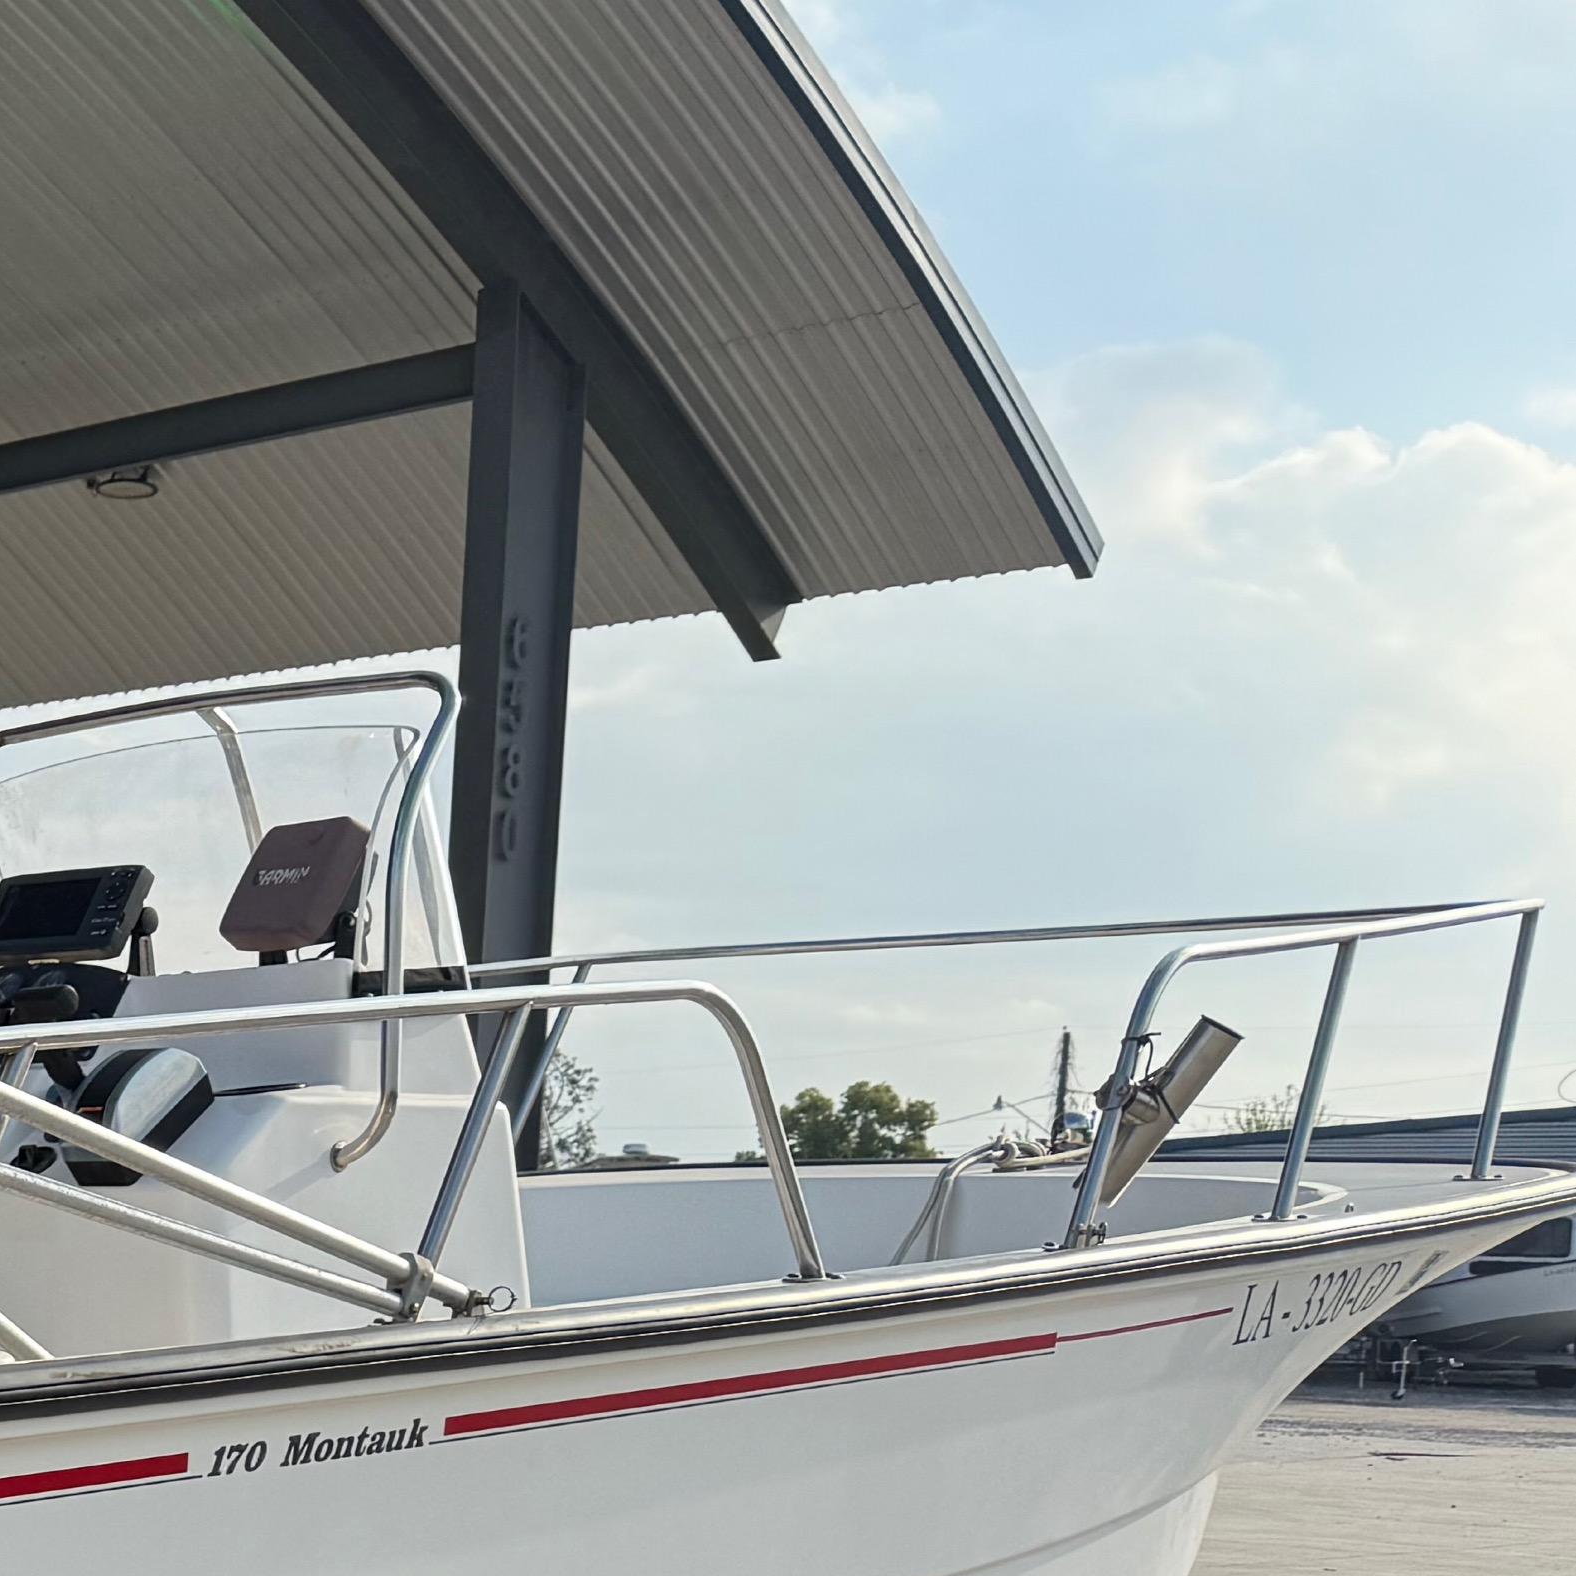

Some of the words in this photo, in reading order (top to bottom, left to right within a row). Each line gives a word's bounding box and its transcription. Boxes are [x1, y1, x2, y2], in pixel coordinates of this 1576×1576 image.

[1232, 1280, 1279, 1346] LA
[207, 1439, 267, 1478] 170
[280, 1418, 430, 1467] Montauk
